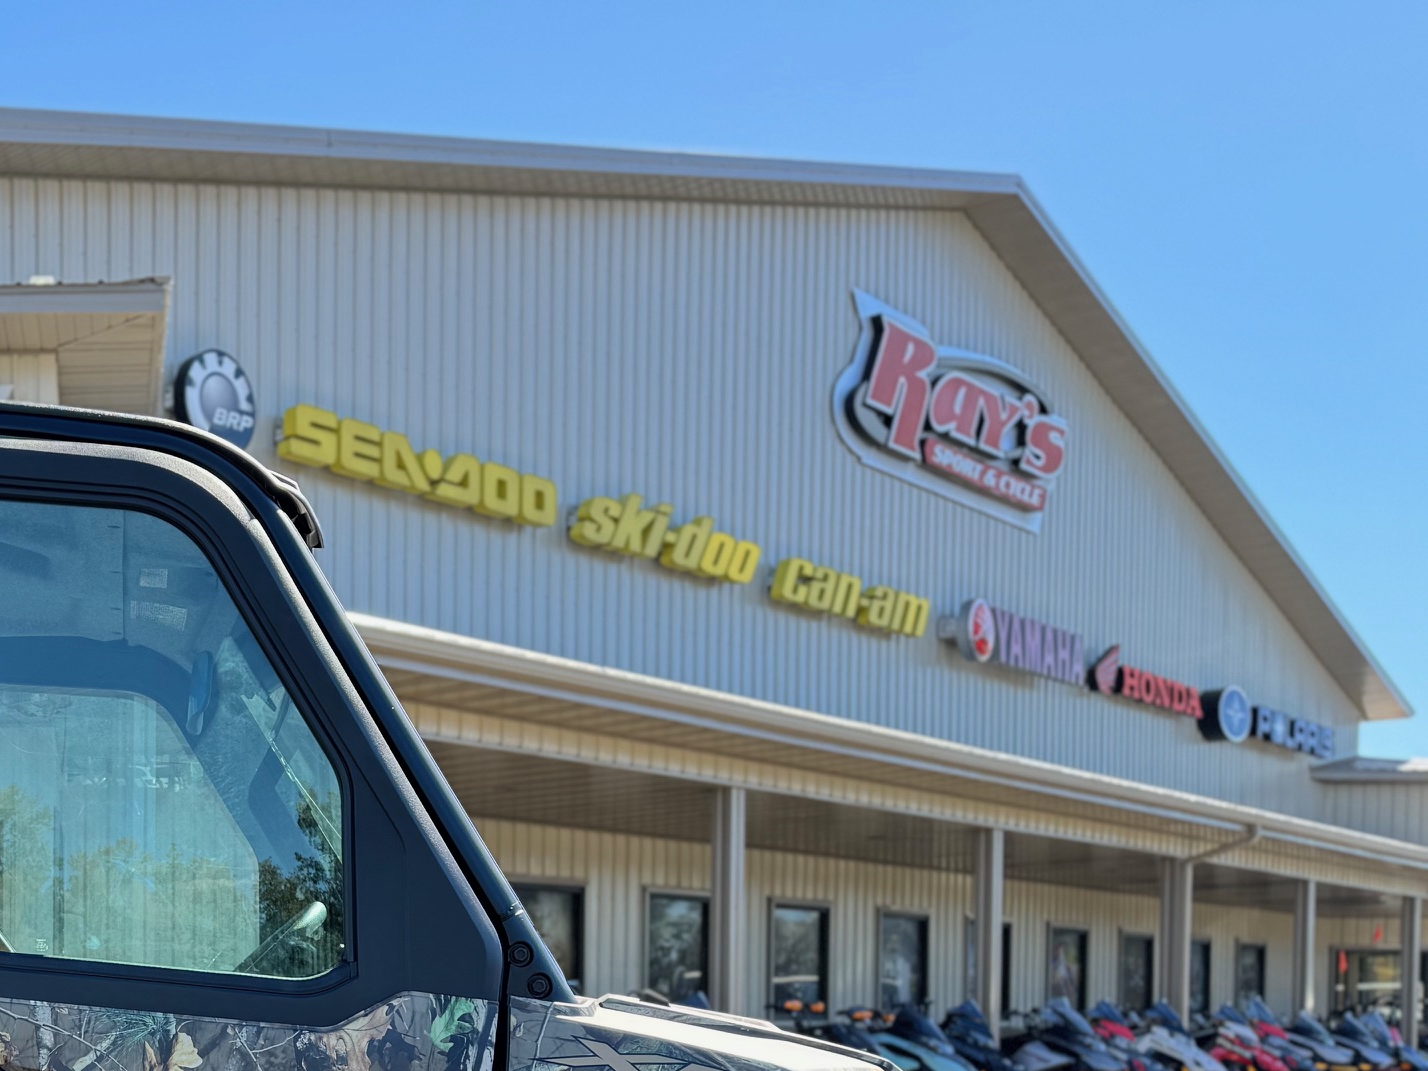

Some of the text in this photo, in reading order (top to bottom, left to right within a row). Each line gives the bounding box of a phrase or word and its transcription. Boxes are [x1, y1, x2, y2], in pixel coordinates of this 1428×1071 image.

[212, 406, 255, 432] BRP
[864, 314, 1068, 479] Ray's
[932, 444, 1044, 506] SPORT & CYCLE
[992, 608, 1085, 687] YAMAHA
[1122, 665, 1203, 720] HONDA
